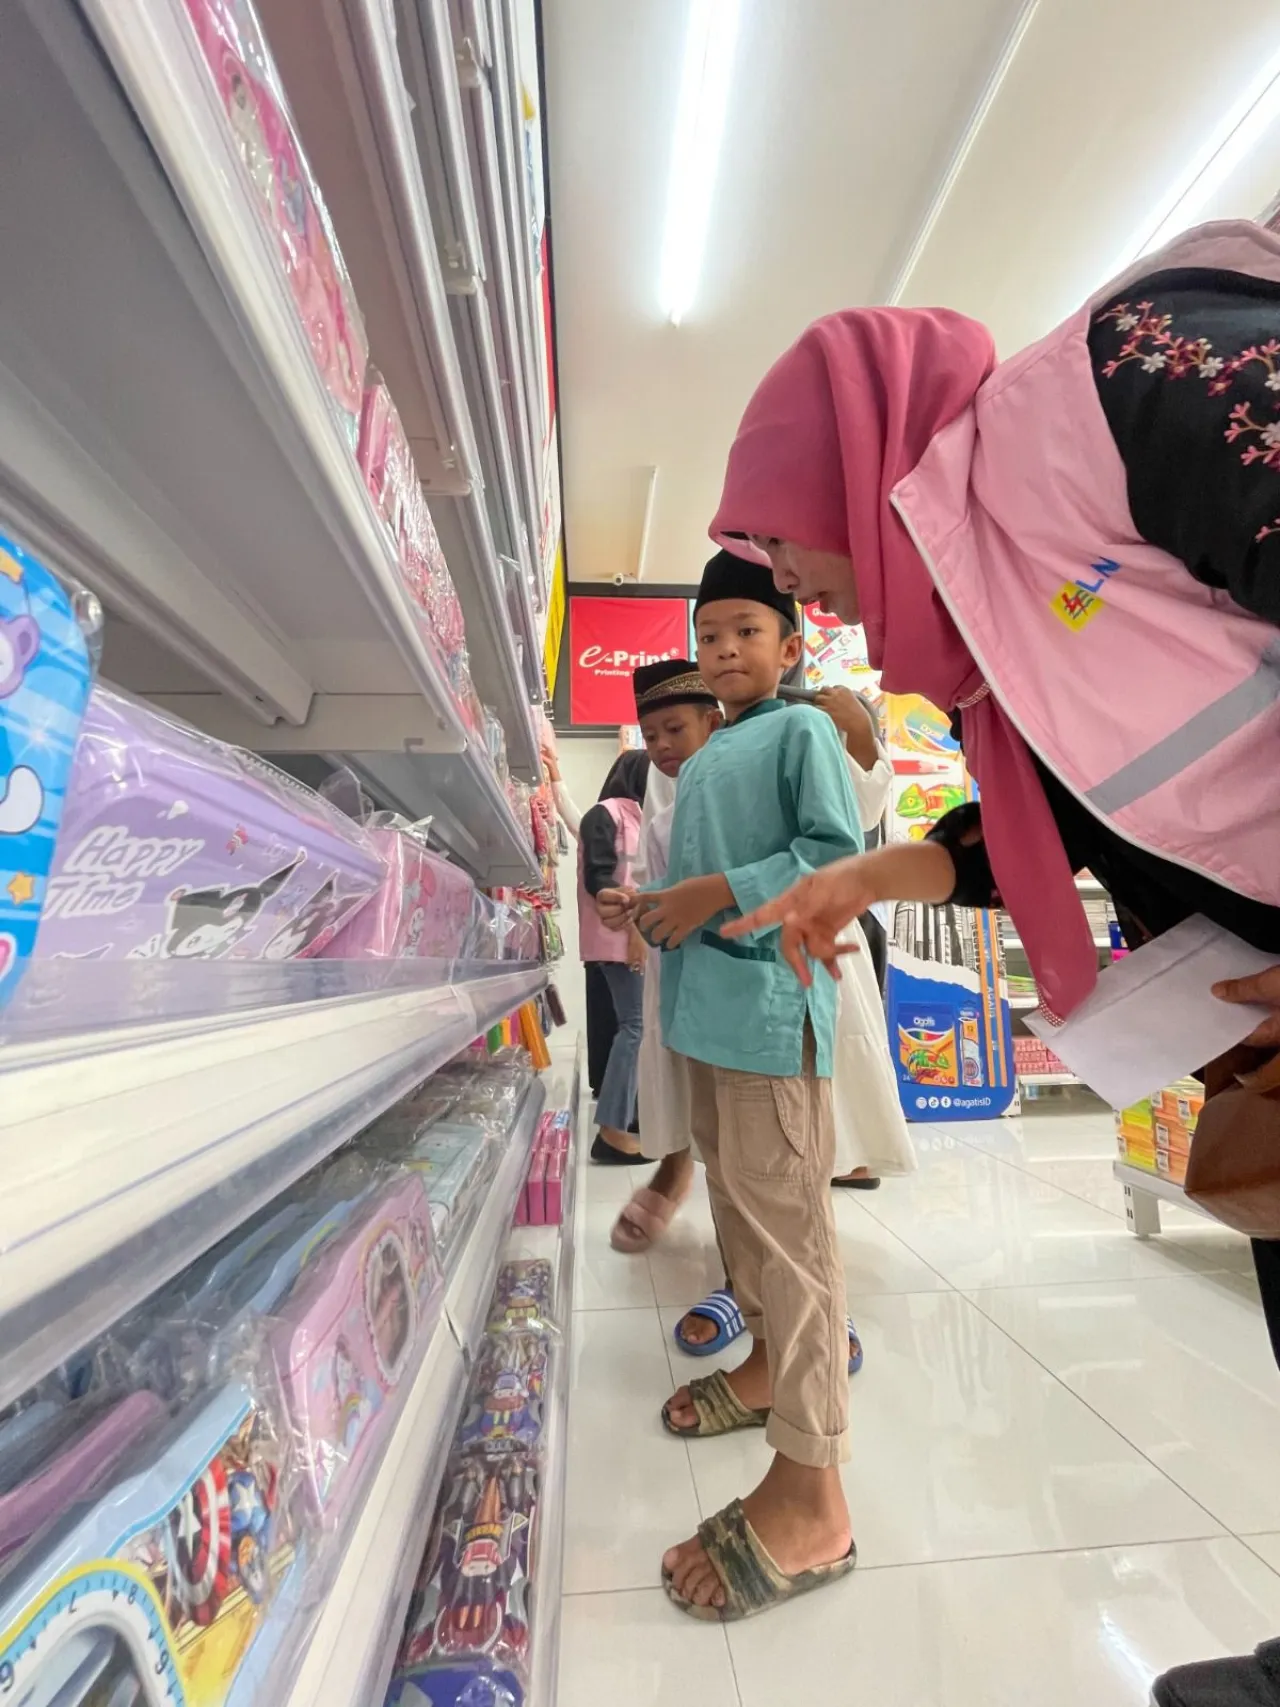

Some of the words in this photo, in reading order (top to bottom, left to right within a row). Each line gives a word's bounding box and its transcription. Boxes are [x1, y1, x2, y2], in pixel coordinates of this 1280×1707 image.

[594, 669, 630, 677] Printing
[63, 825, 205, 878] Happy
[42, 874, 146, 920] Time
